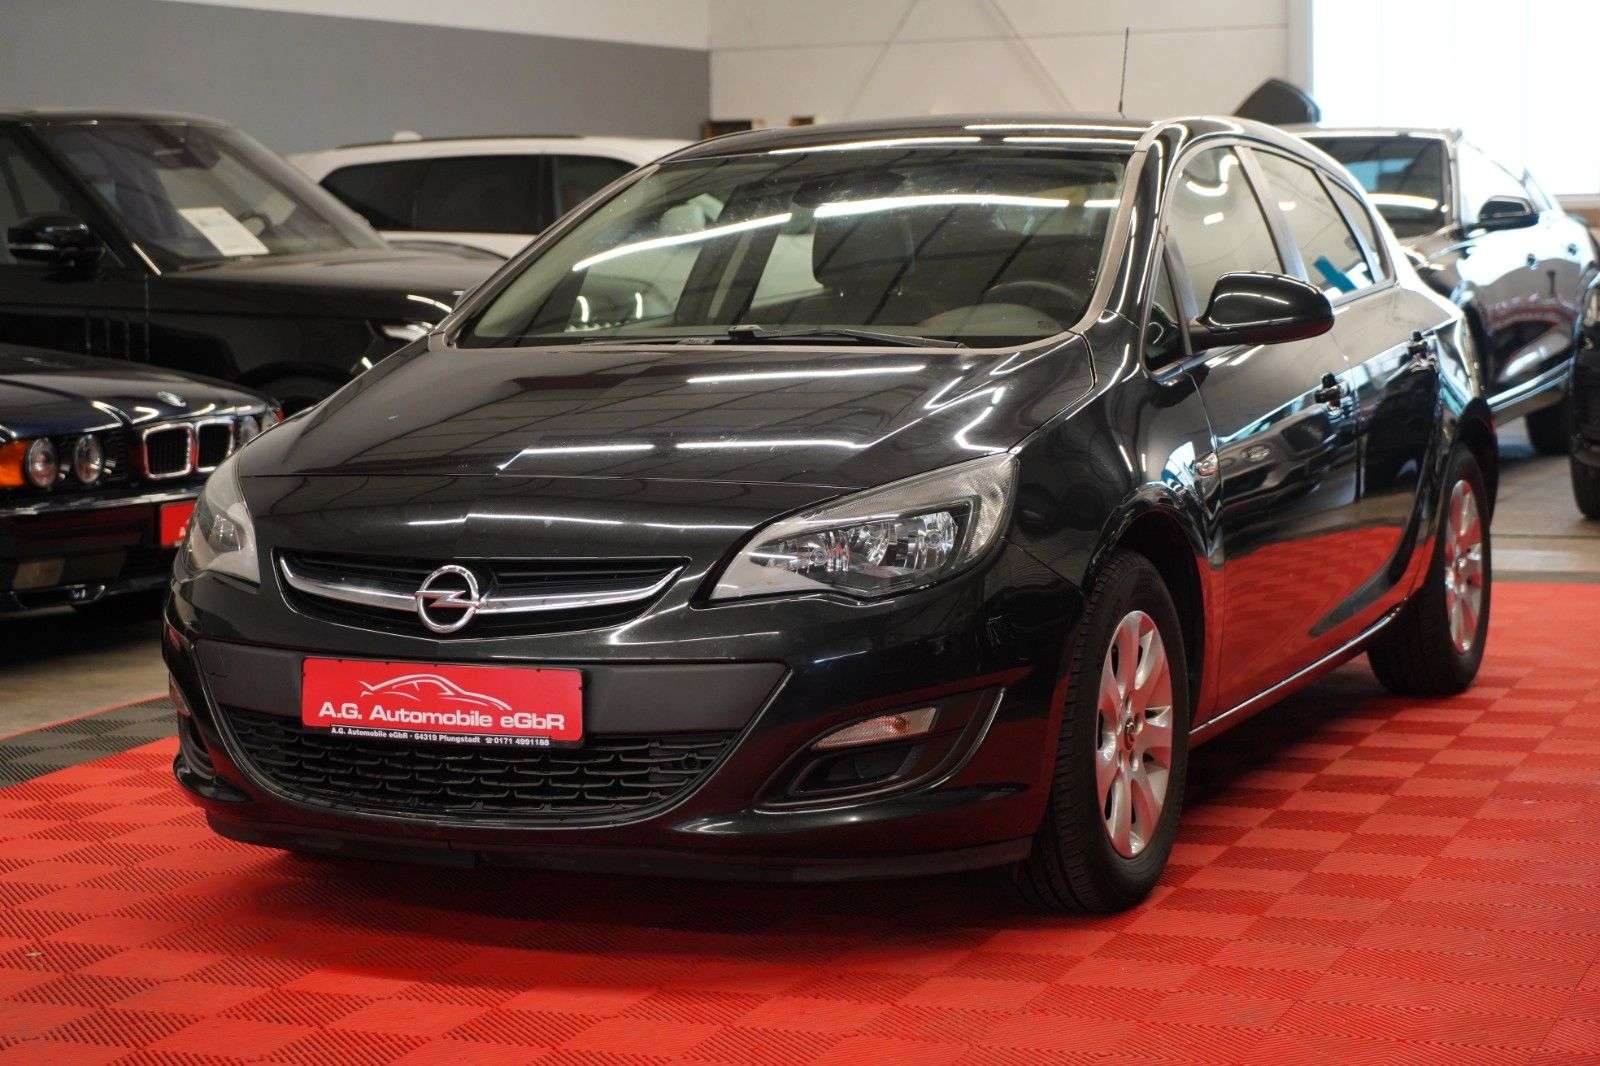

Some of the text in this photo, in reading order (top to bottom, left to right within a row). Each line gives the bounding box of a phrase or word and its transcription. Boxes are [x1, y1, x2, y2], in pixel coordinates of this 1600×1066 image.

[318, 701, 565, 730] A.G. Automobile eGbR
[347, 728, 387, 738] Automobile
[389, 731, 408, 739] eGbR
[439, 734, 481, 744] Pfungstedt
